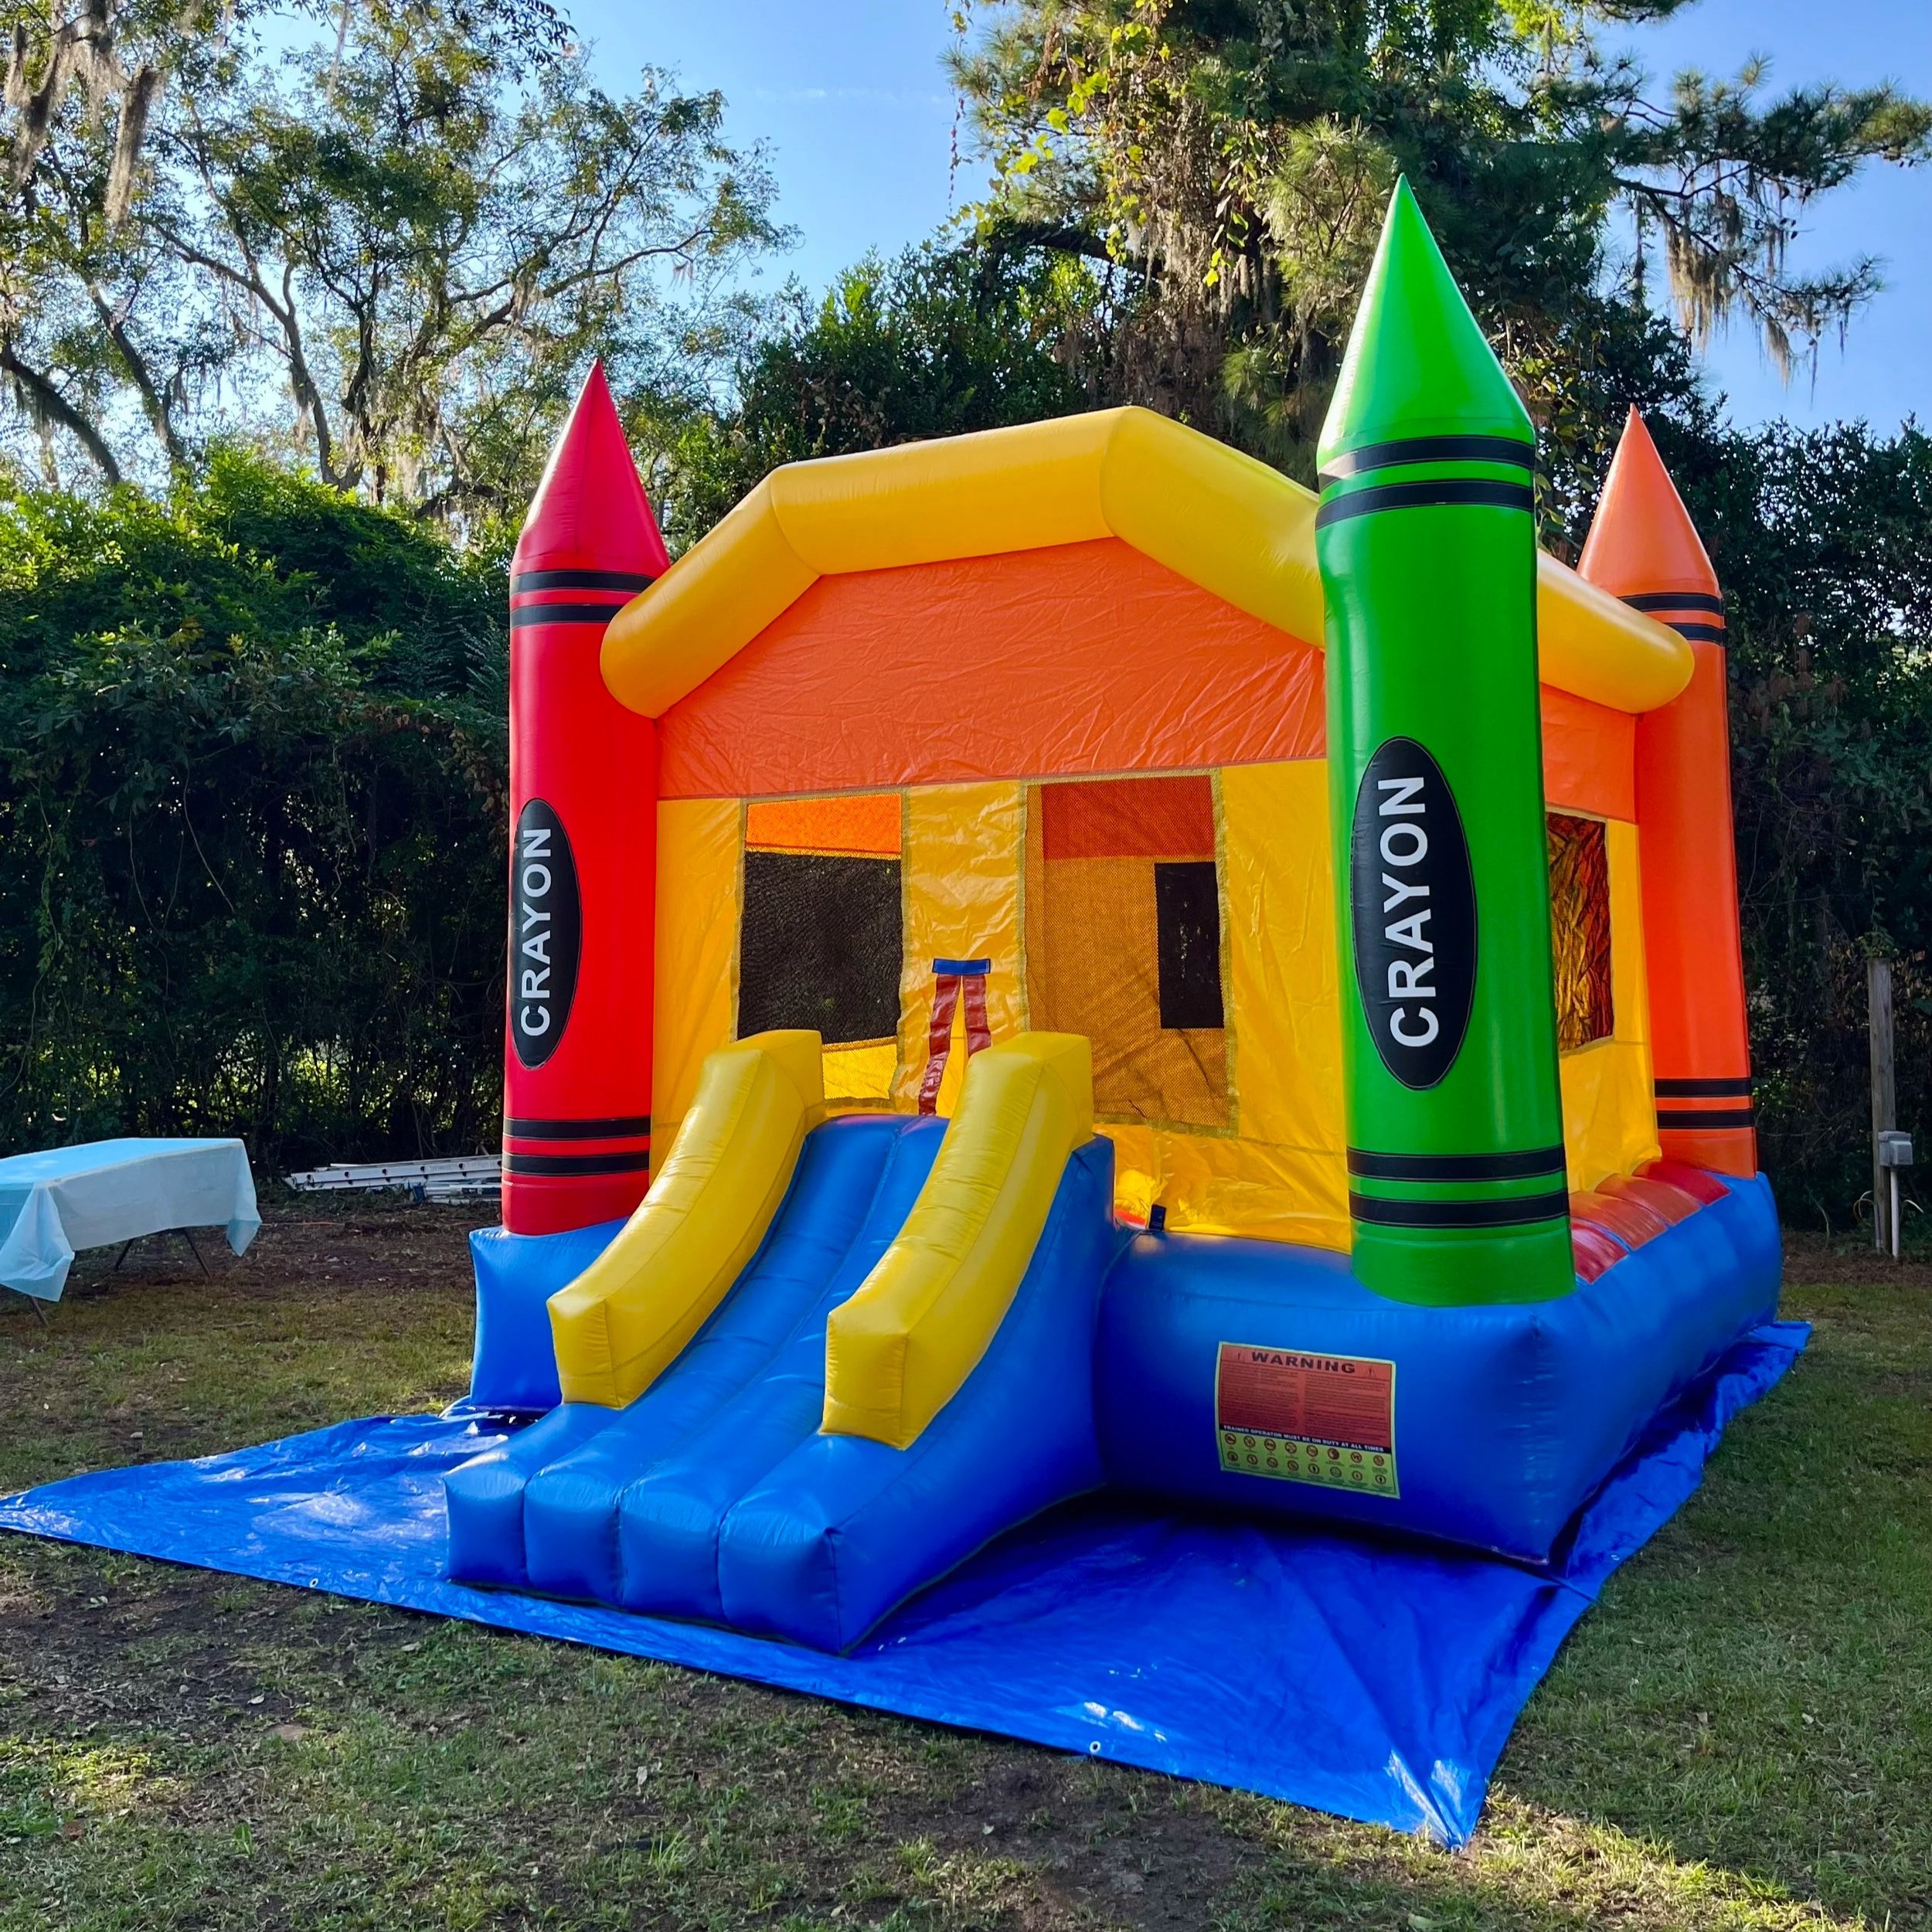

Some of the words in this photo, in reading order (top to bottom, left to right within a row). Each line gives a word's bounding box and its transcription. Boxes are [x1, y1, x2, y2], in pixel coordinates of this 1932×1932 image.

[520, 828, 552, 1036] CRAYON
[1377, 776, 1439, 1047] CRAYON
[1252, 1352, 1355, 1373] WARNING
[1250, 1429, 1282, 1437] OPERATOR
